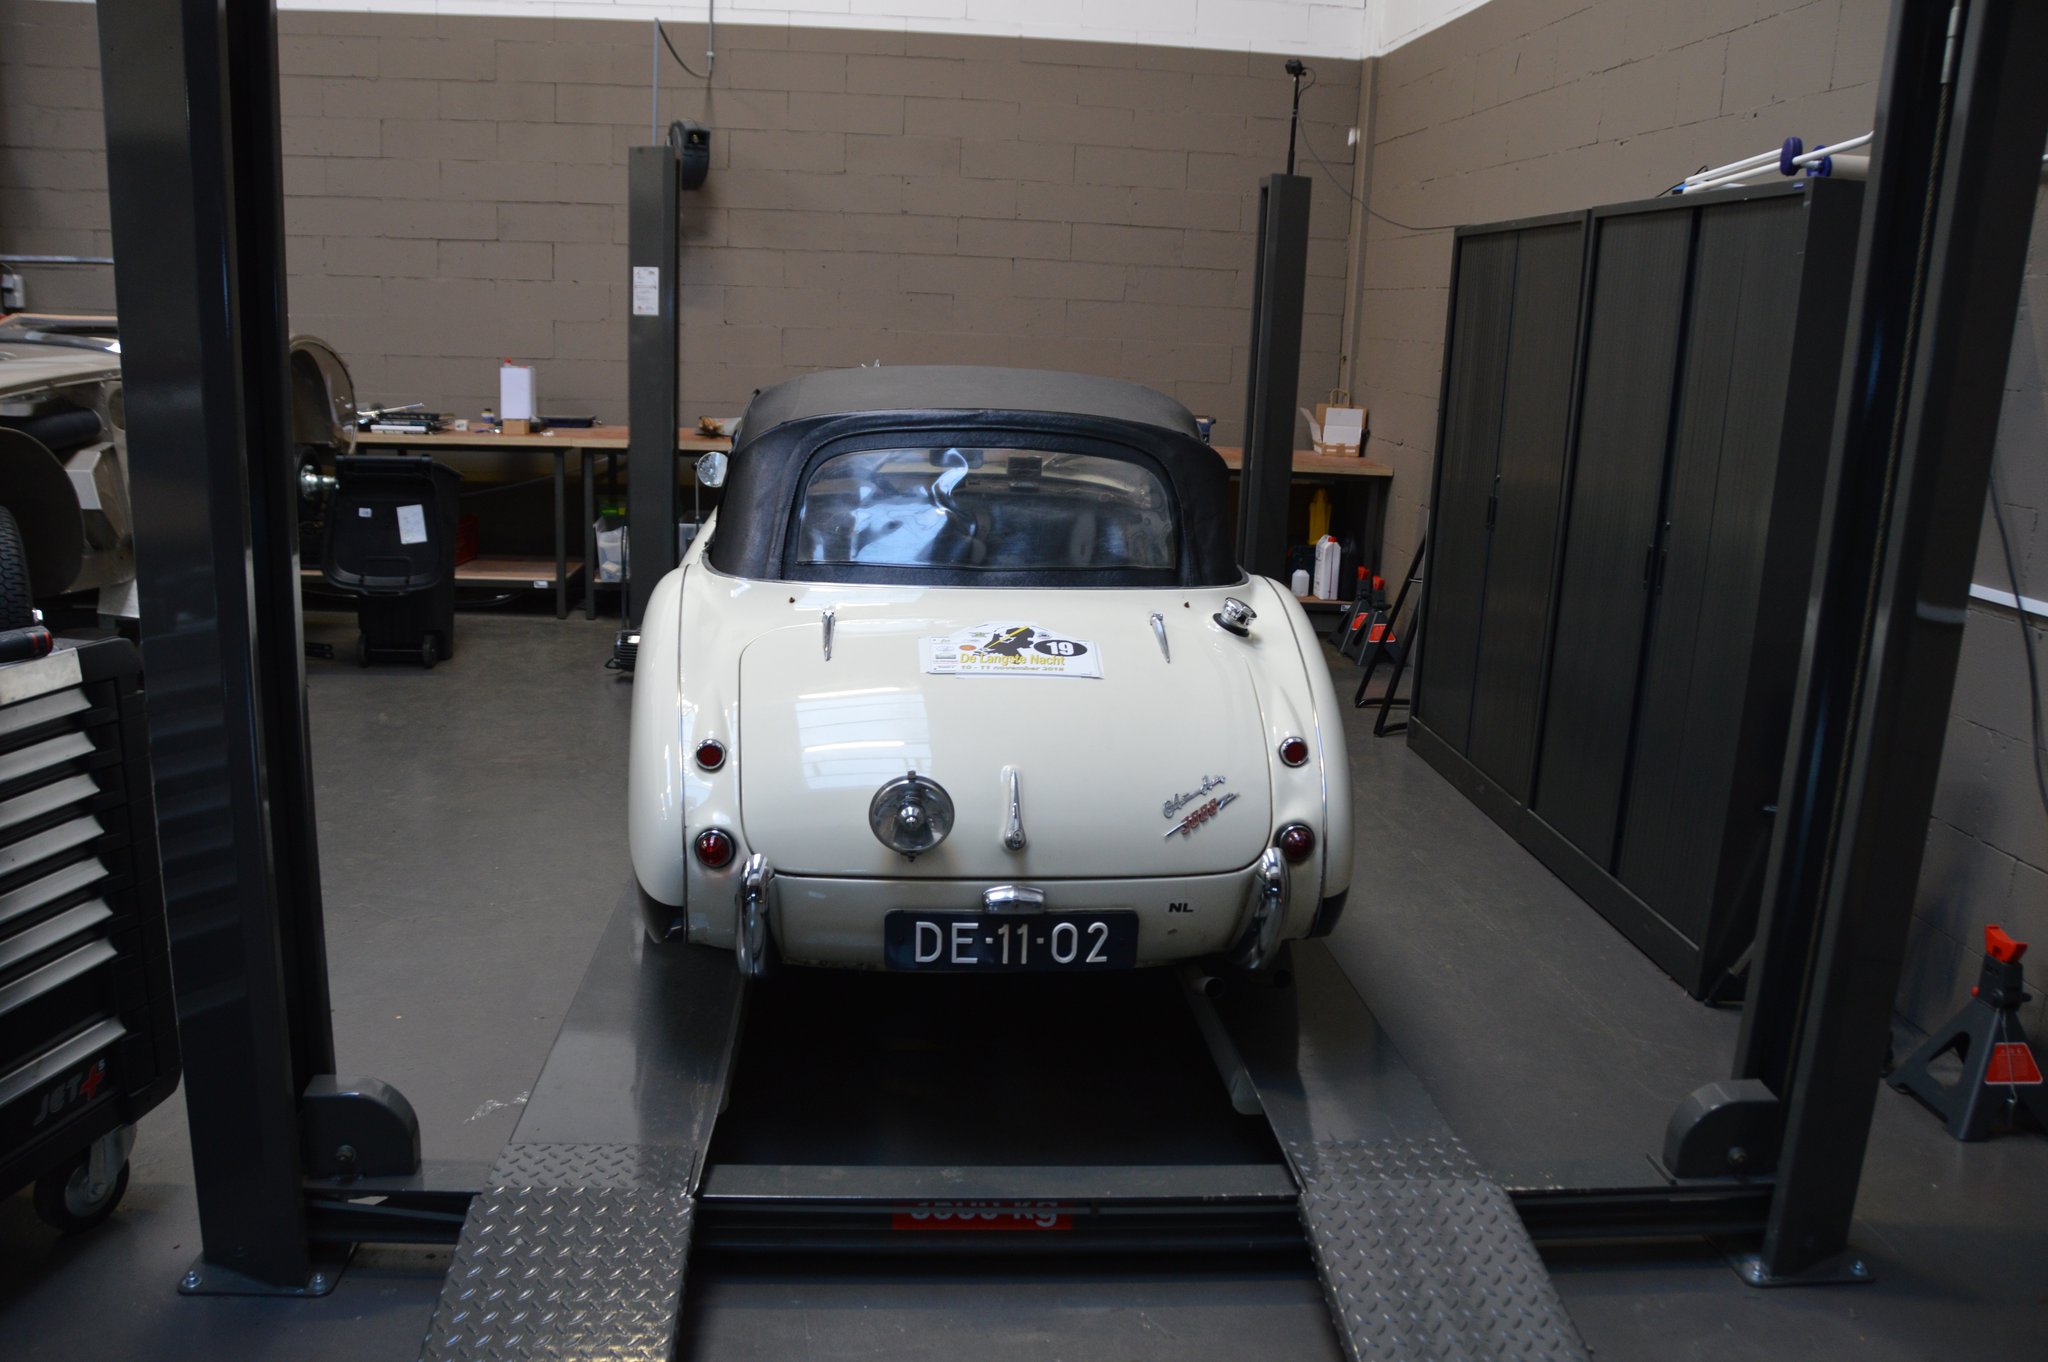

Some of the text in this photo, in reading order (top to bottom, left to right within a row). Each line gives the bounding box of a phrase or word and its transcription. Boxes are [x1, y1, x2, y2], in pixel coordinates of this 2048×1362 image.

[1046, 641, 1075, 656] 19
[960, 653, 977, 664] De
[979, 653, 1027, 666] Langste
[1030, 654, 1065, 666] Nacht
[1168, 902, 1194, 913] NL
